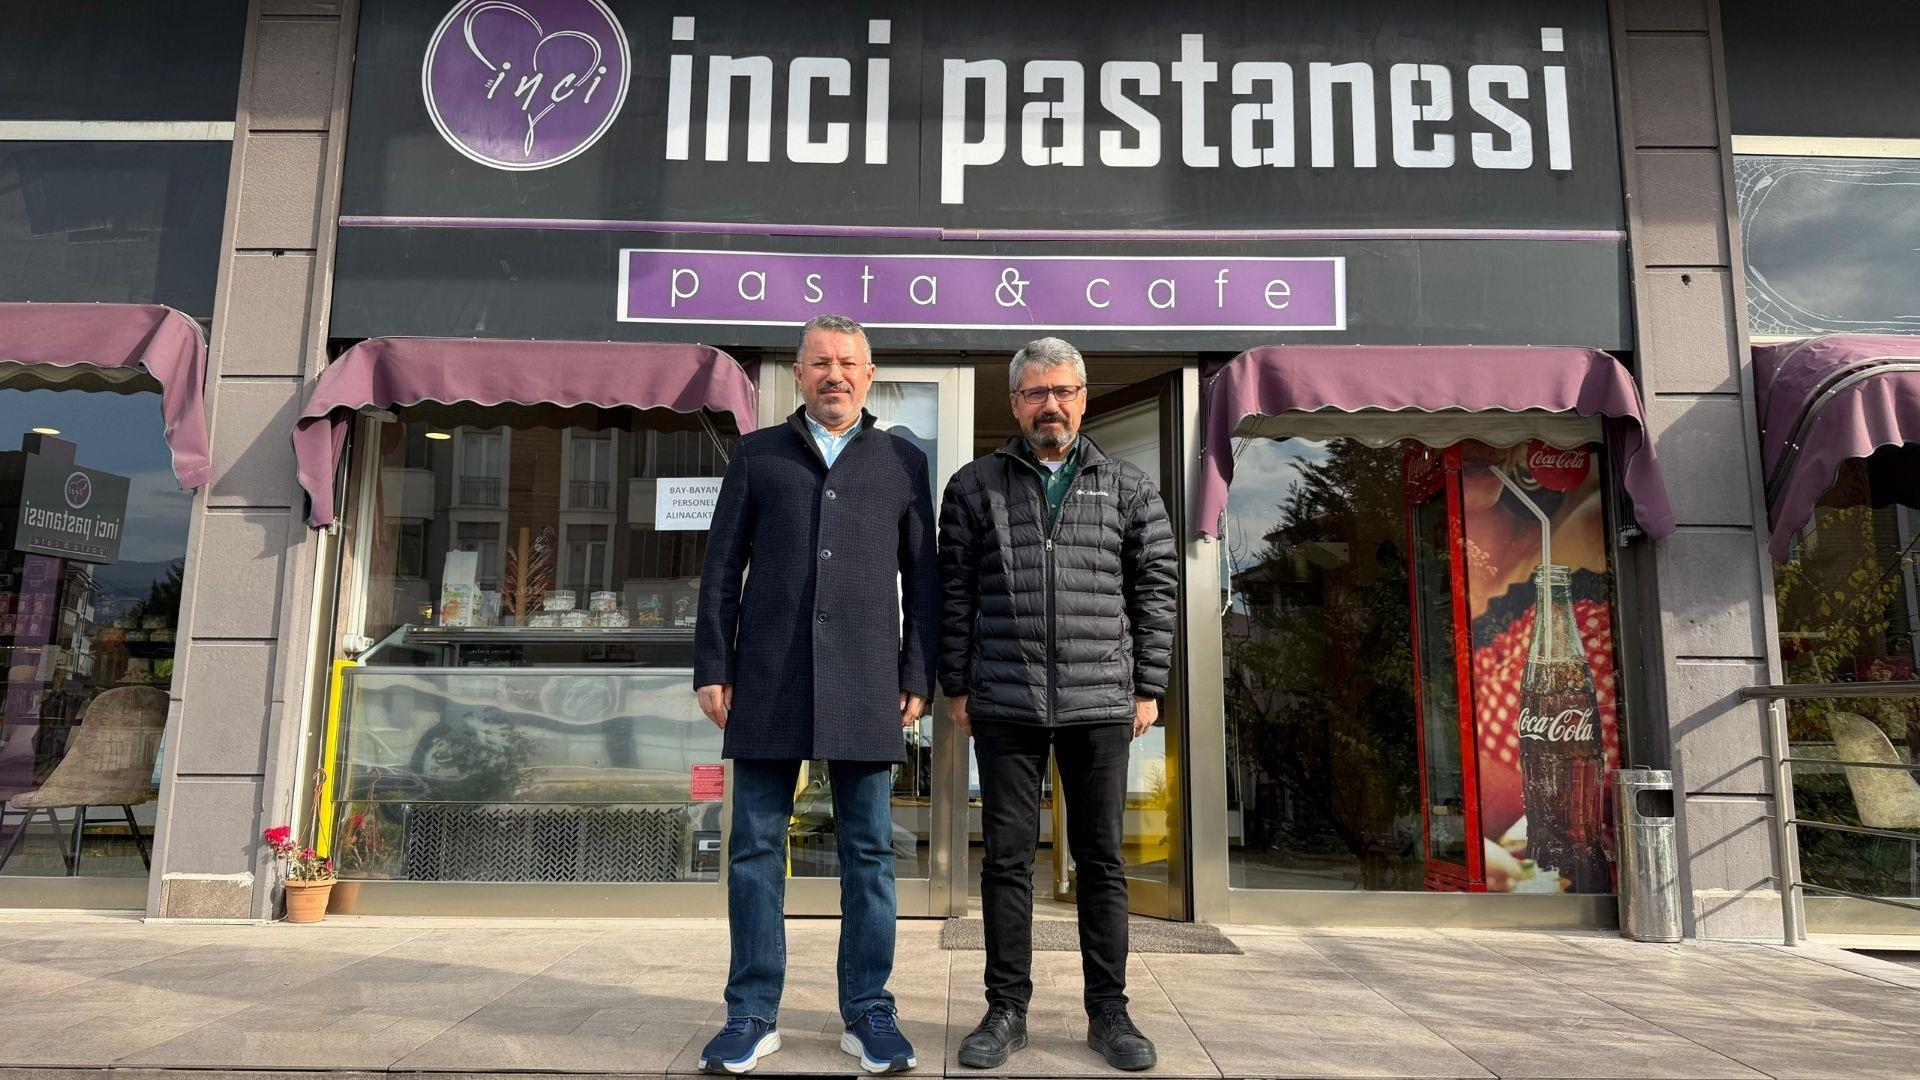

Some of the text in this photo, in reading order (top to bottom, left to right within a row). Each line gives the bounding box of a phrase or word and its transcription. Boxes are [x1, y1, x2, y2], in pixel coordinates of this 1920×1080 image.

[487, 62, 607, 111] inci
[666, 16, 1572, 205] inci pastanesi
[671, 265, 1291, 309] pasta & cafe
[1530, 450, 1585, 469] Coca-Cola
[669, 486, 719, 494] BAY-BAYAN
[672, 499, 716, 507] PERSONEL
[665, 511, 713, 519] ALINACAKT
[1517, 707, 1594, 742] Coca-Cola
